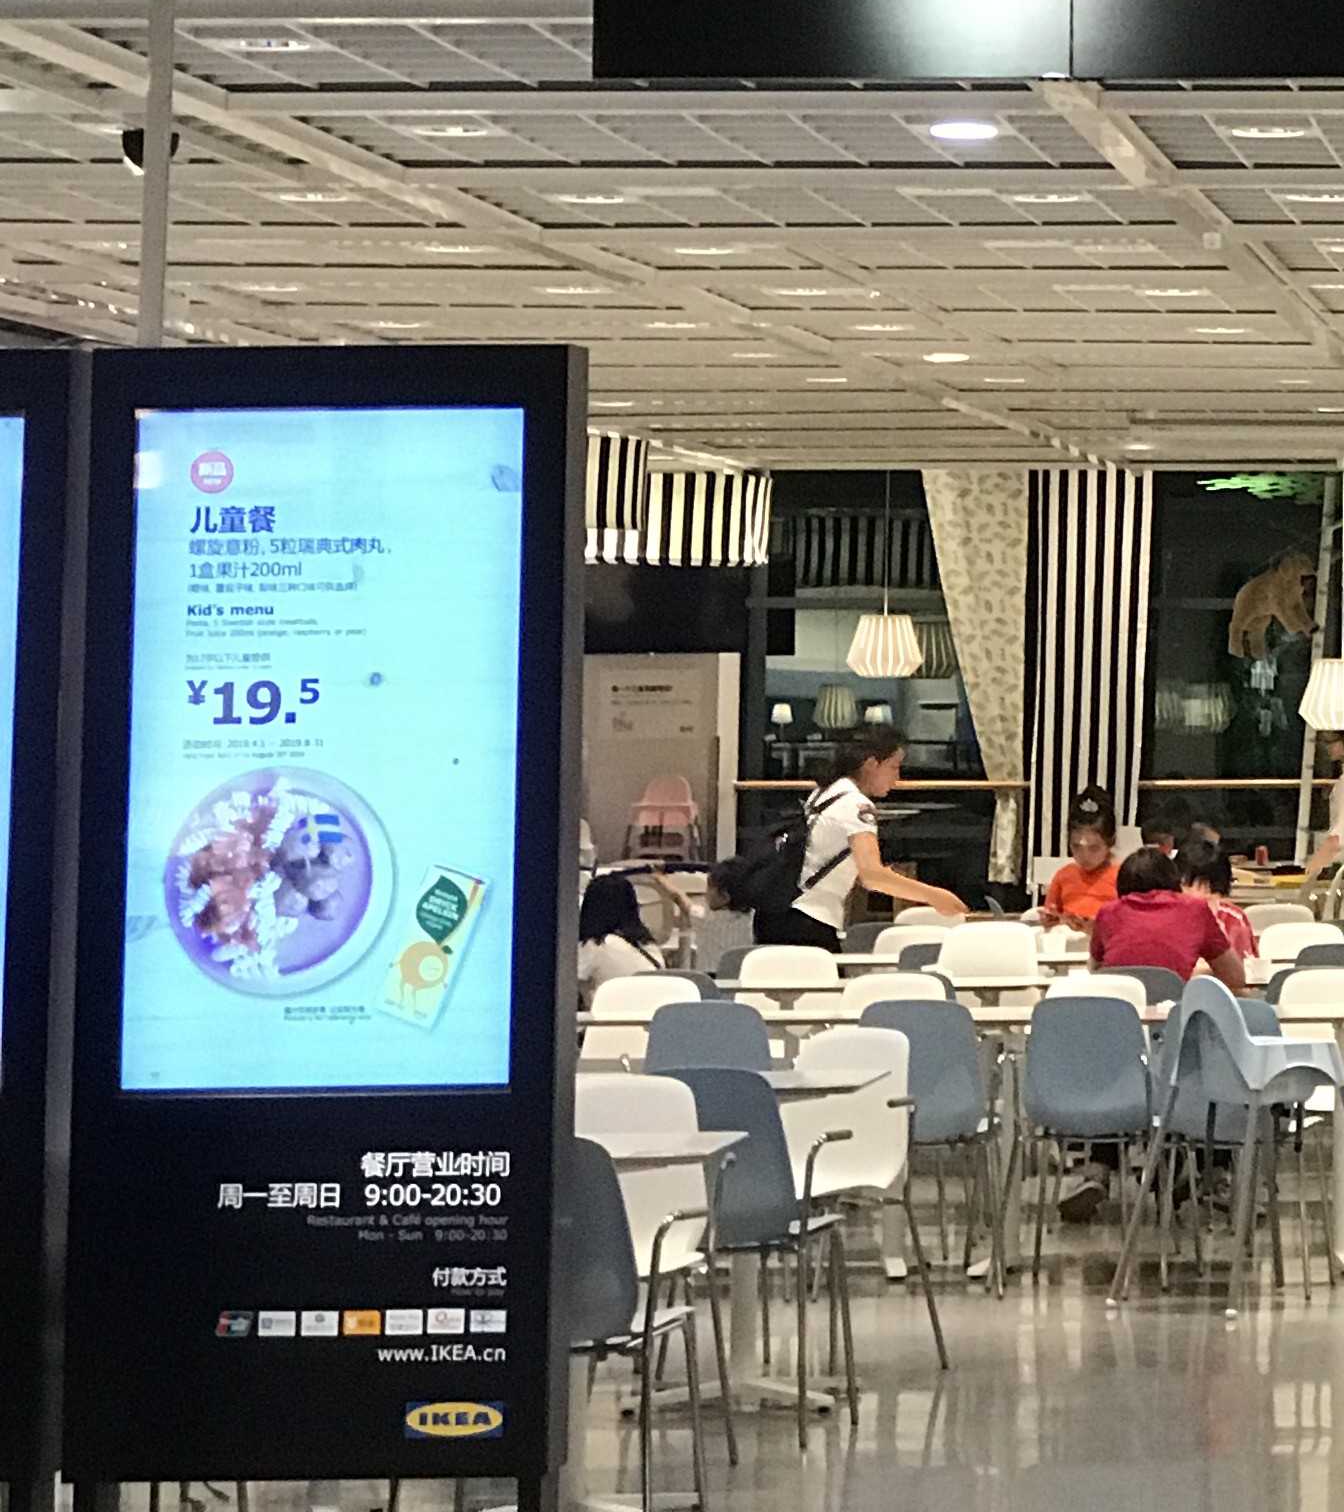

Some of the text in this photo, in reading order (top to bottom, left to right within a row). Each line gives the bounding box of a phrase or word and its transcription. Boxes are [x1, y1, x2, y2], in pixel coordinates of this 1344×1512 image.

[190, 505, 276, 533] 儿童餐
[190, 561, 302, 579] 1盒果汁200ml
[187, 604, 274, 616] Kid's menu
[360, 1151, 510, 1178] 餐厅营业时间
[217, 1182, 501, 1208] 周一至周日 9:00-20:30
[398, 1229, 423, 1241] Sun
[432, 1266, 507, 1287] 付款方式
[378, 1344, 506, 1362] www.IKEA.cn
[418, 1411, 492, 1426] IKEA
